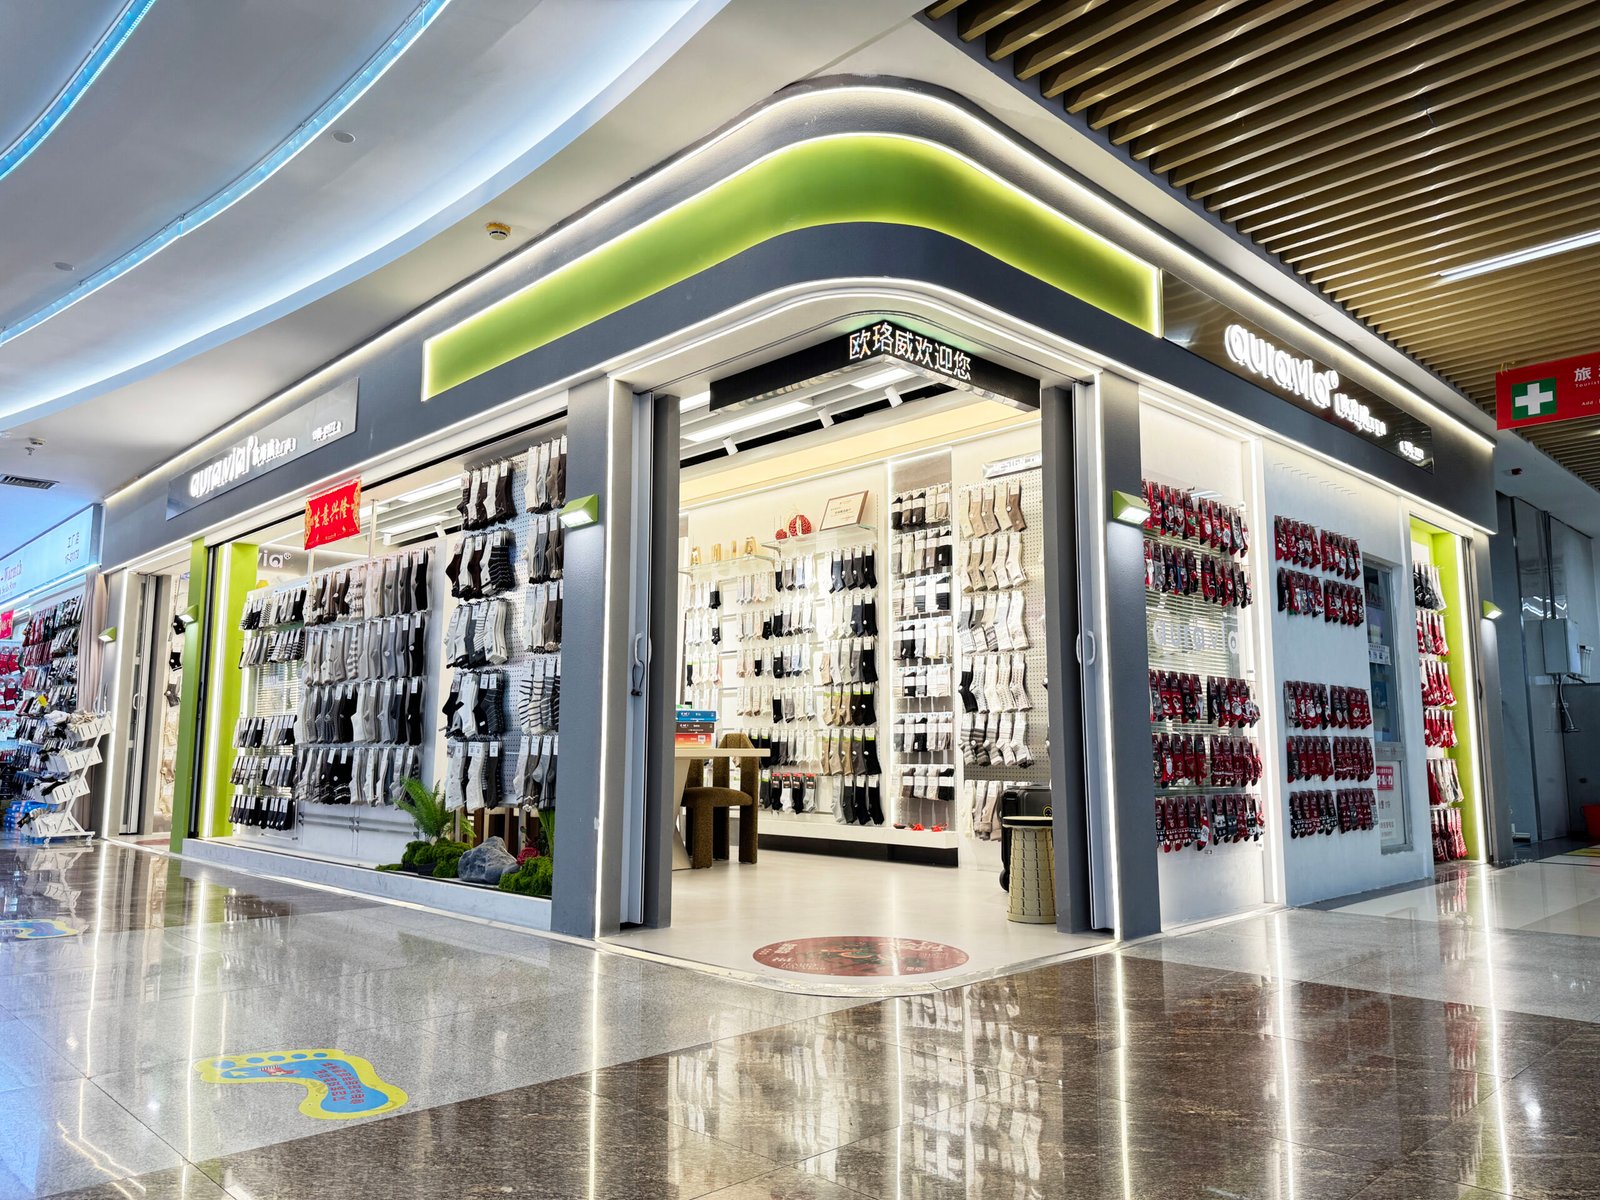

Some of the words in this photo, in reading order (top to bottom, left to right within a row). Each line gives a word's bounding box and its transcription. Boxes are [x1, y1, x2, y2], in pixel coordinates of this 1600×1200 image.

[849, 321, 972, 381] 欧珞威欢迎您
